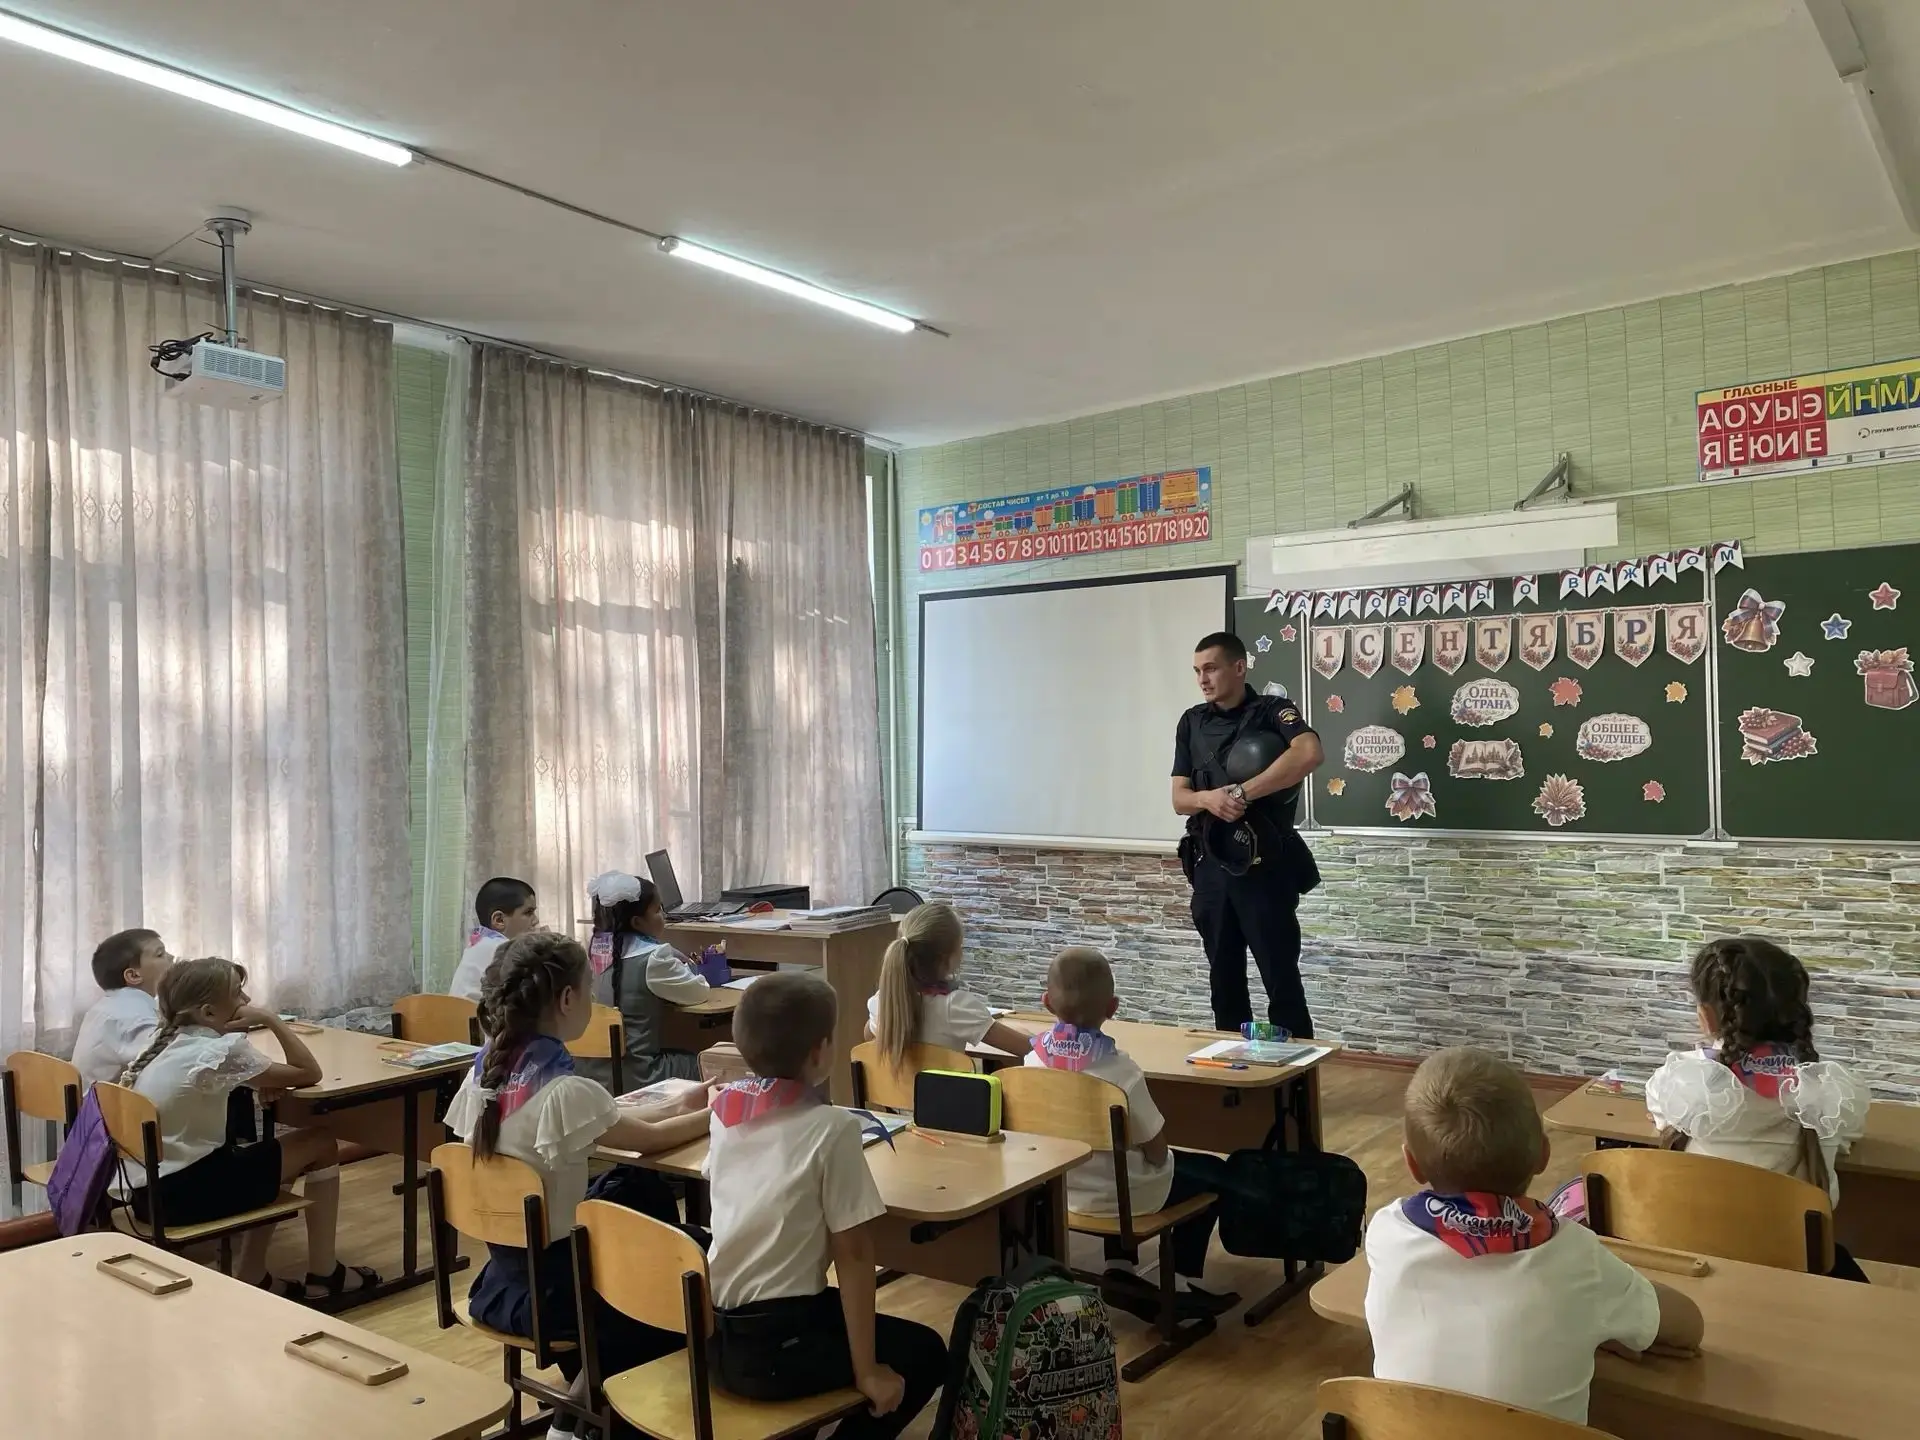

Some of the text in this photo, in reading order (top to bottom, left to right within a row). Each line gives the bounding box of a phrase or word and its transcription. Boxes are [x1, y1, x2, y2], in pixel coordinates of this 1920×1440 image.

[1723, 380, 1797, 399] ГЛАСНЫЕ
[978, 501, 1005, 510] СОСТАВ
[1007, 496, 1030, 505] ЧИСЕЛ
[922, 515, 1209, 569] 0 1 2 3 4 5 6 7 8 9 10 11 12 13 14 15 16 17 18 19 20
[1275, 550, 1734, 610] РАЗГОВОРЫ О ВАЖНОМ
[1323, 615, 1698, 658] 1 СЕНТЯБРЯ
[1469, 686, 1508, 698] ОДНА
[1463, 698, 1512, 709] СТРАНА
[1592, 723, 1639, 734] ОБЩЕЕ
[1356, 735, 1395, 745] ОБЩАЯ
[1591, 734, 1646, 745] БУДУЩЕЕ
[1356, 745, 1400, 754] ИСТОРИЯ
